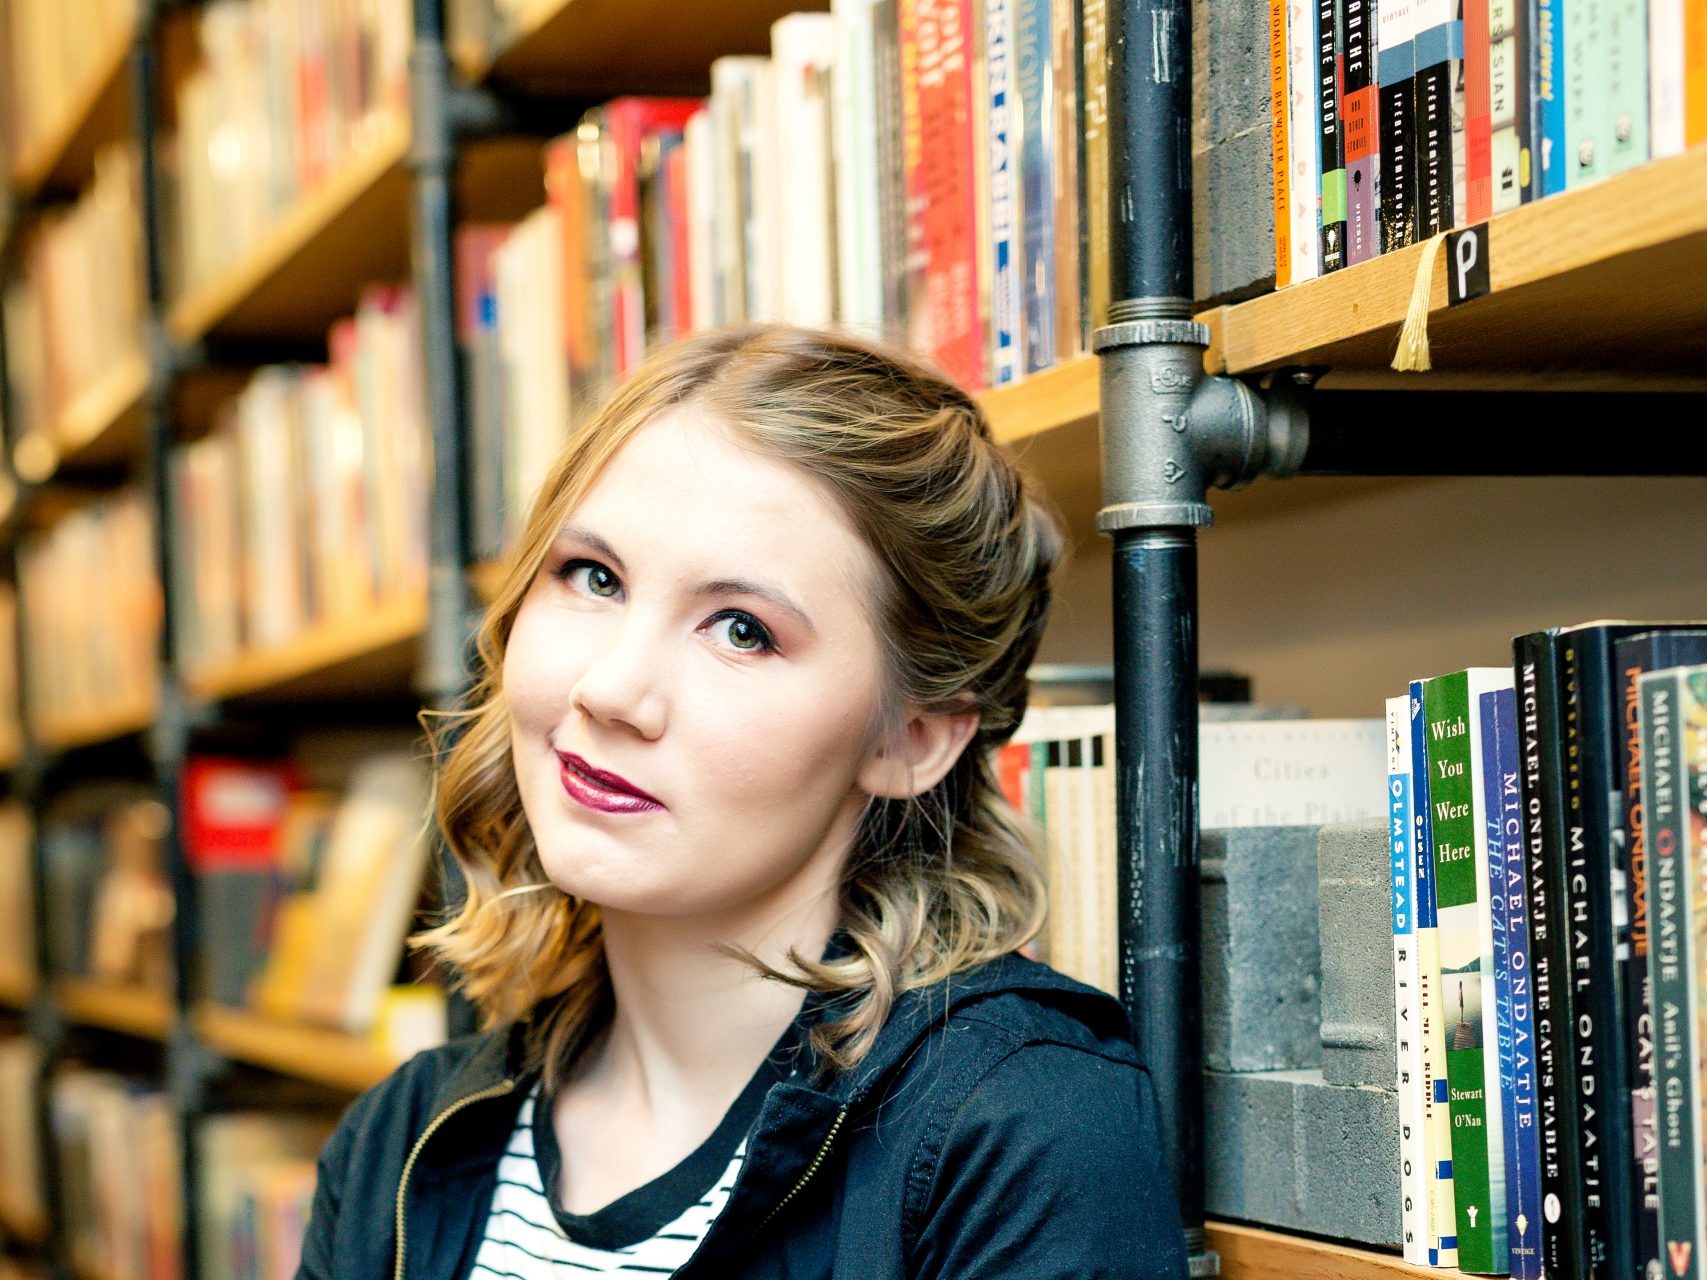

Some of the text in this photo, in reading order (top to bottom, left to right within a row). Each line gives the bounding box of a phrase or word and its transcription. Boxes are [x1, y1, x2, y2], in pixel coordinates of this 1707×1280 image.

[1273, 4, 1285, 211] WOMEN OF BREWSTER PLACE
[1322, 30, 1332, 65] THE
[1322, 75, 1334, 135] BLOOD
[1431, 716, 1466, 741] Wish
[1437, 759, 1463, 779] You
[1392, 779, 1406, 929] OLMSTEAD
[1415, 815, 1425, 878] OLSEN
[1436, 801, 1470, 822] Were
[1439, 843, 1471, 863] Here
[1652, 690, 1679, 983] MICHAEL ONDAATJE
[1488, 817, 1512, 1090] THE CAT'S TABLE
[1504, 772, 1532, 1128] MICHAEL ONDAATJE
[1523, 663, 1559, 1178] MICHAEL ONDAATJE THE CAT'S TABLE
[1421, 973, 1433, 1120] TELL ME A RIDDLE
[1569, 826, 1600, 1208] MICHAEL ONDAATJE
[1662, 1001, 1684, 1147] Anil's Ghost
[1398, 948, 1413, 1244] RIVER DOGS
[1451, 1087, 1483, 1102] Stewart
[1454, 1114, 1482, 1128] O'Nan
[1642, 1110, 1660, 1209] TABLE
